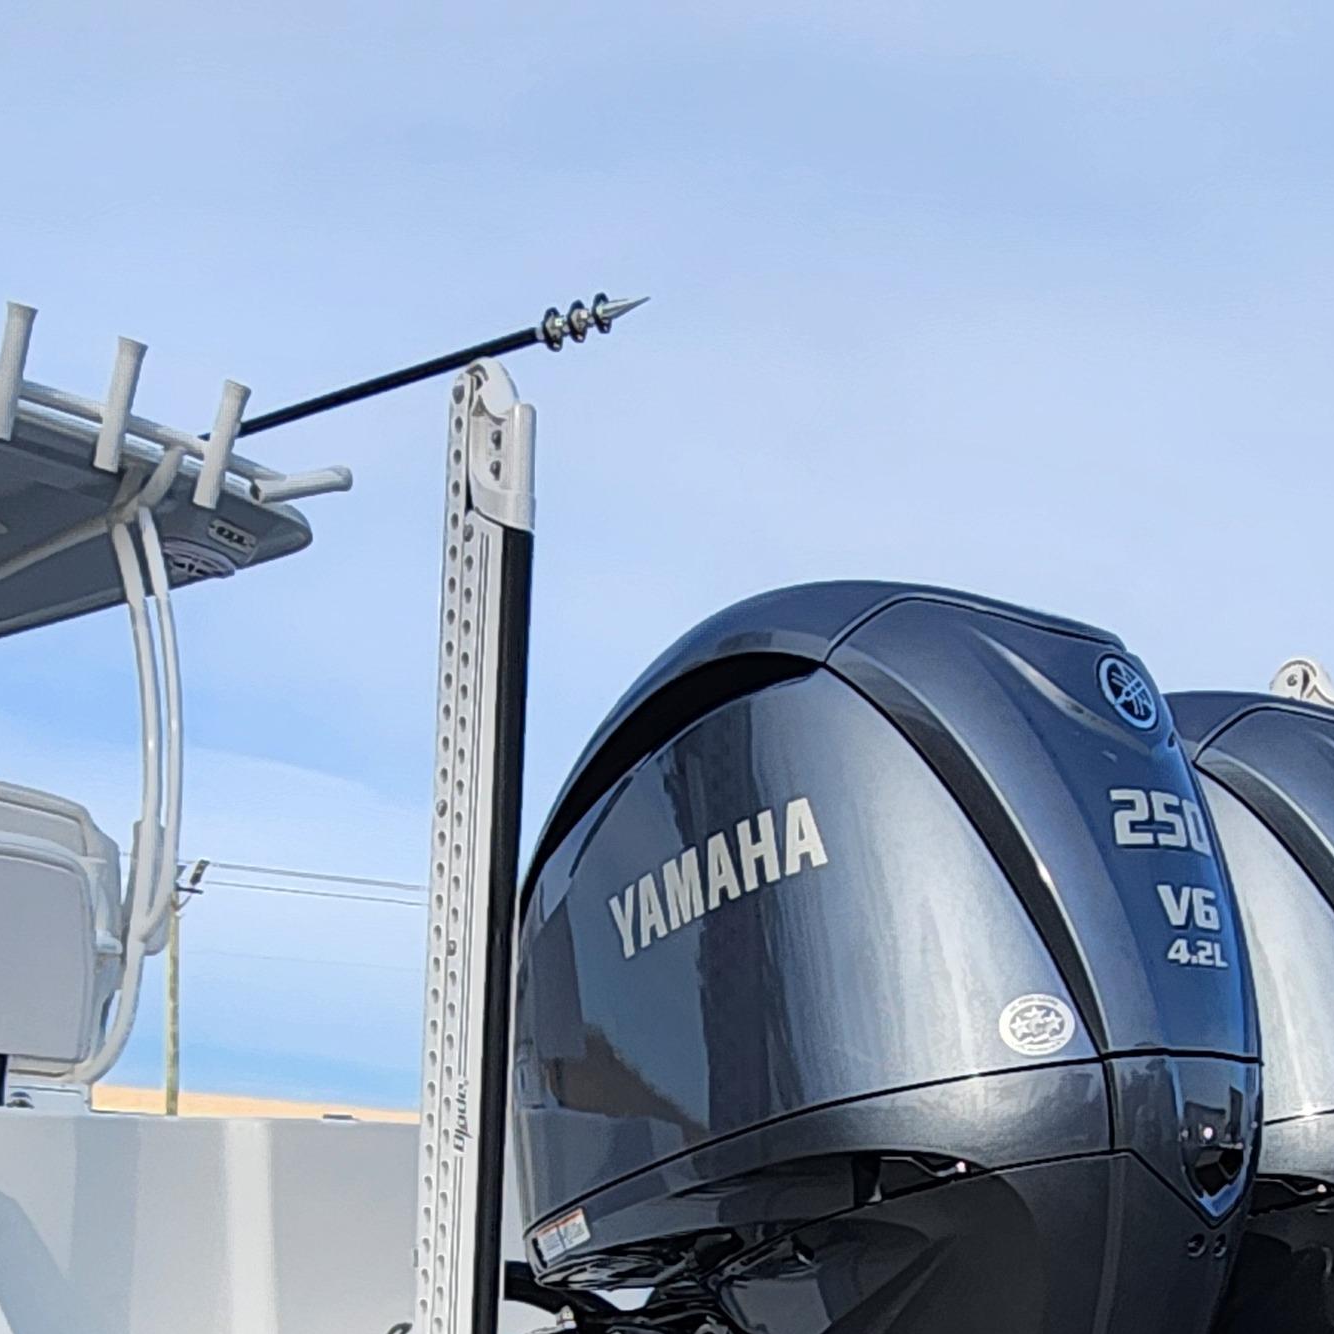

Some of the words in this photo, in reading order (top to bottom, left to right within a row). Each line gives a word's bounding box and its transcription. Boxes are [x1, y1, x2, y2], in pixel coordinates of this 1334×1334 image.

[1109, 787, 1212, 858] 250
[608, 797, 829, 960] YAMAHA
[1156, 884, 1221, 931] V6
[1167, 937, 1229, 968] 4.2L
